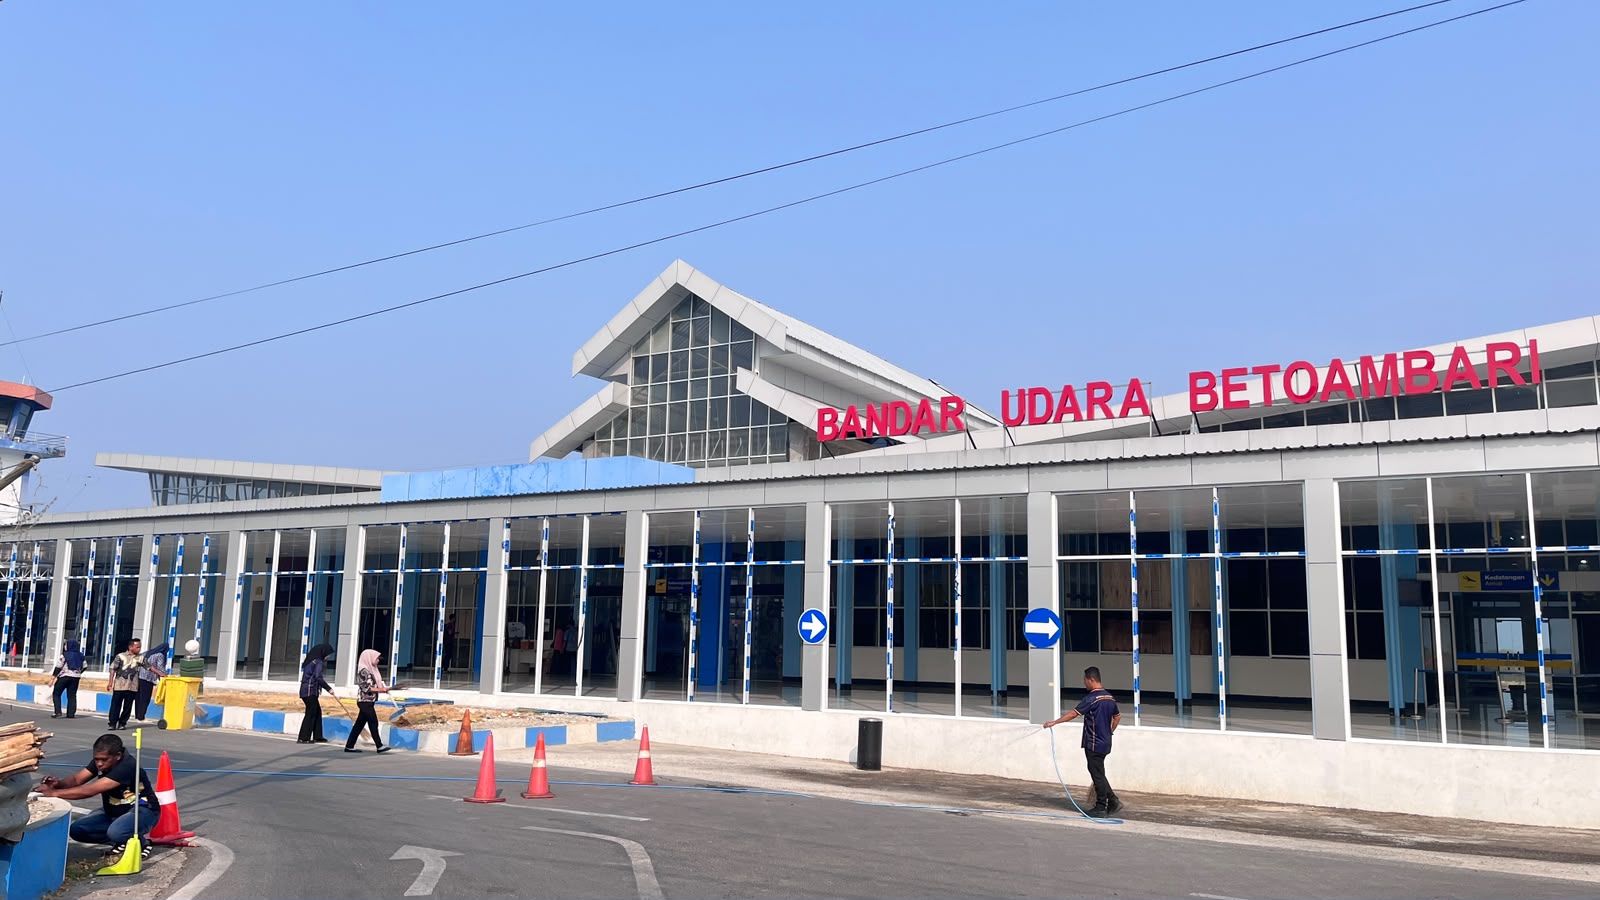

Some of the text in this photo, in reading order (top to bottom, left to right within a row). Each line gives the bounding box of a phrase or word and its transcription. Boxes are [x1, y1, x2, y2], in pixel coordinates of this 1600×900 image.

[816, 338, 1542, 442] BANDAR UDARA BETOAMBARI
[1484, 574, 1525, 582] Kedatangan
